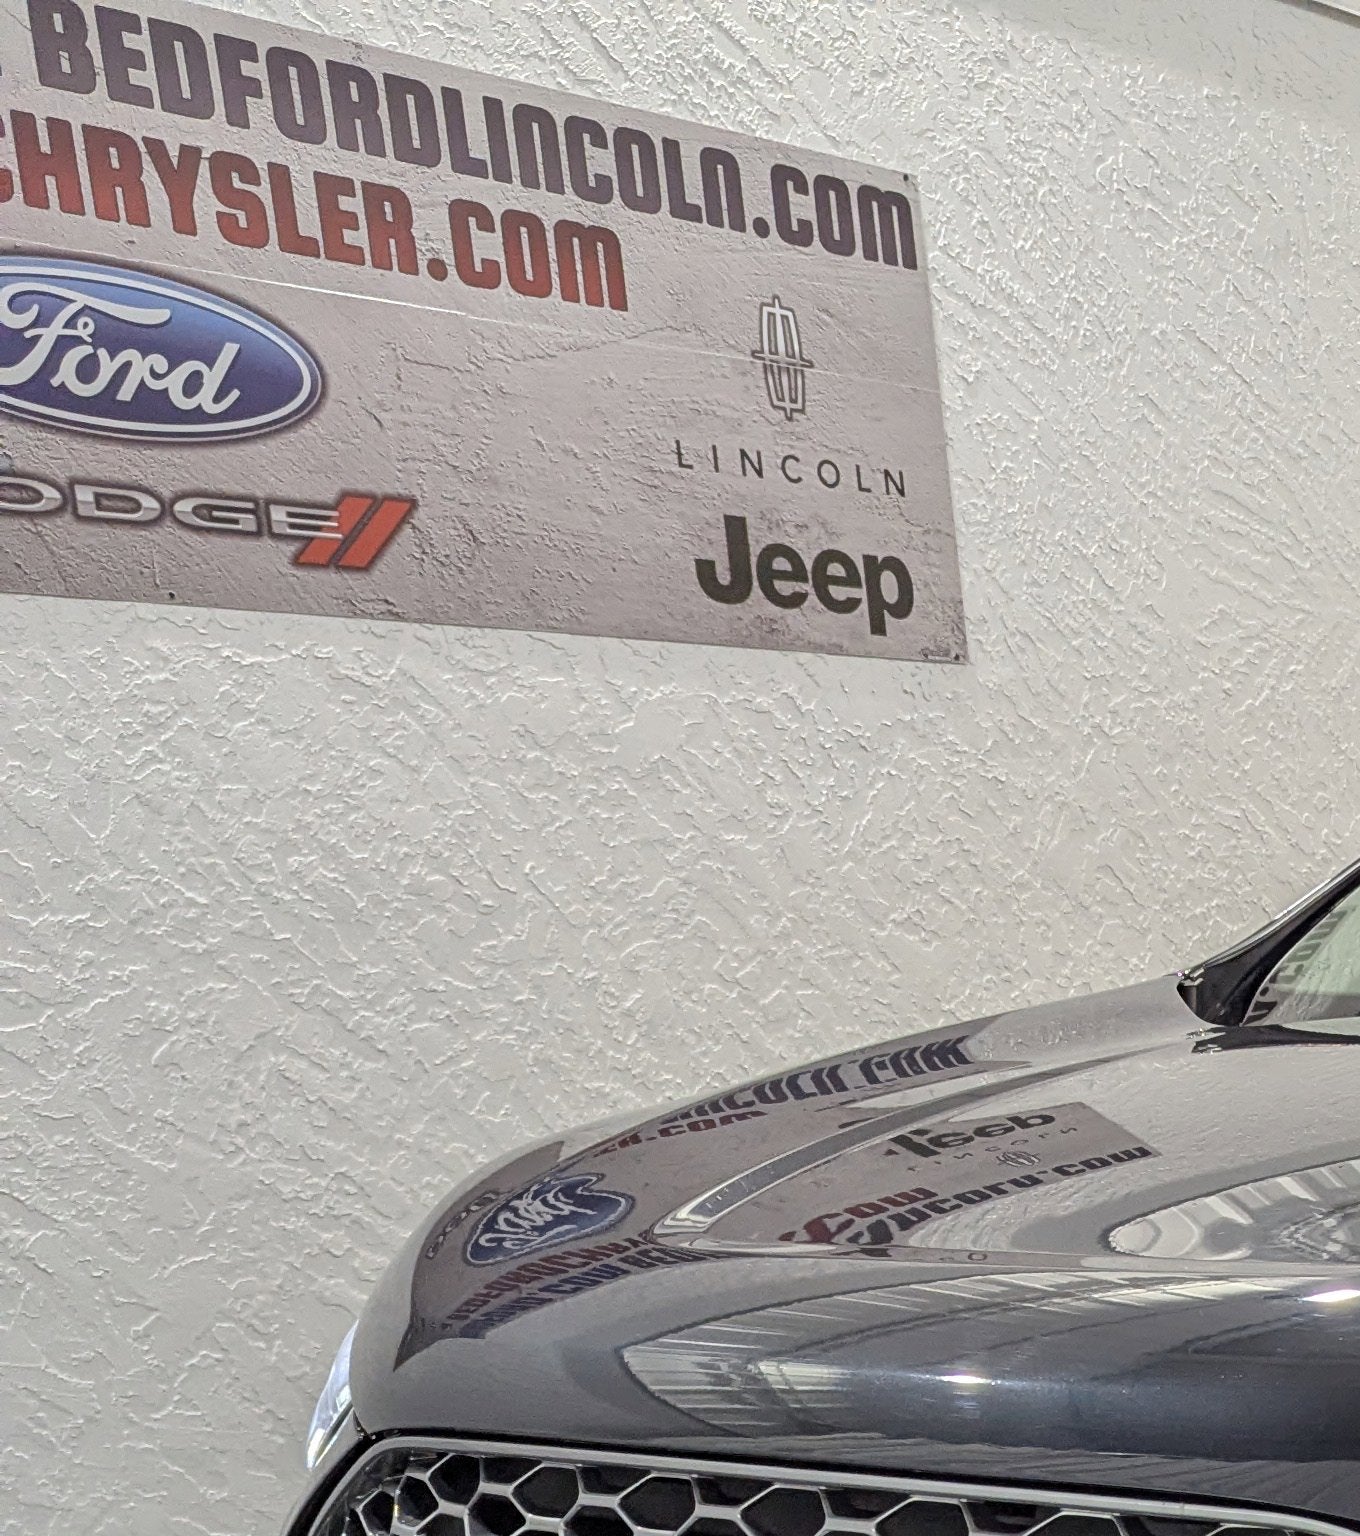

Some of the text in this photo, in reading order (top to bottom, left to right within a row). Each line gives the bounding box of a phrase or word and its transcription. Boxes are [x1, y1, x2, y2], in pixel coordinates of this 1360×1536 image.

[0, 109, 628, 311] HRYSLER.COM
[0, 282, 241, 414] Ford
[675, 440, 905, 497] LINCOLN
[694, 514, 914, 637] Jeep
